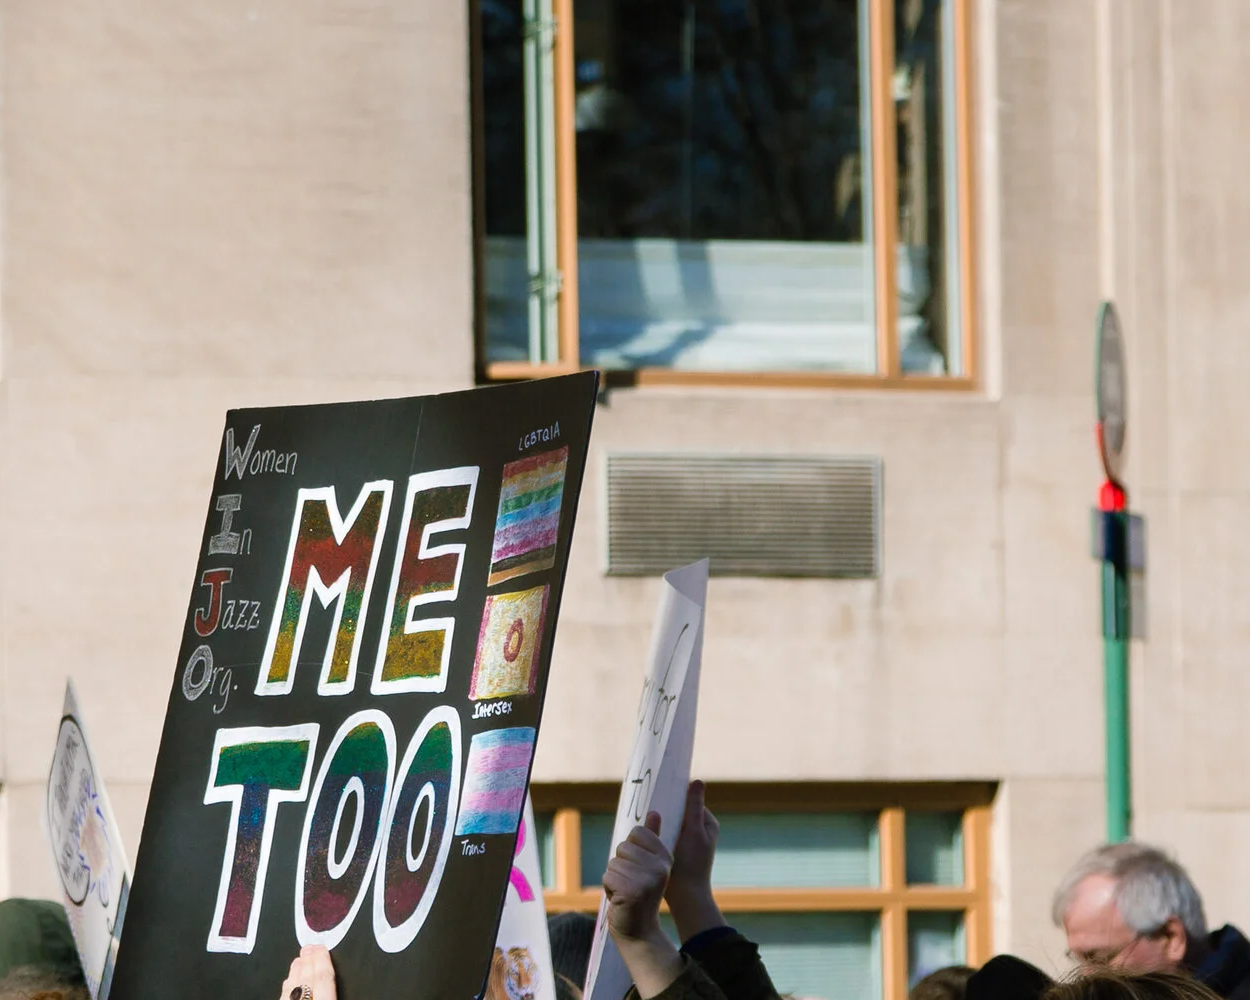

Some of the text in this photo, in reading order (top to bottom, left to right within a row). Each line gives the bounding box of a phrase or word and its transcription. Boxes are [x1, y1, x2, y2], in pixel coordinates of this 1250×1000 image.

[224, 423, 298, 480] Women
[518, 420, 561, 451] LGBTQIA
[208, 493, 252, 556] In
[194, 567, 261, 637] Jazz
[254, 466, 480, 695] ME
[182, 644, 239, 715] Org.
[471, 700, 513, 721] Intersex
[204, 706, 462, 954] TOO
[461, 839, 486, 857] Trans
